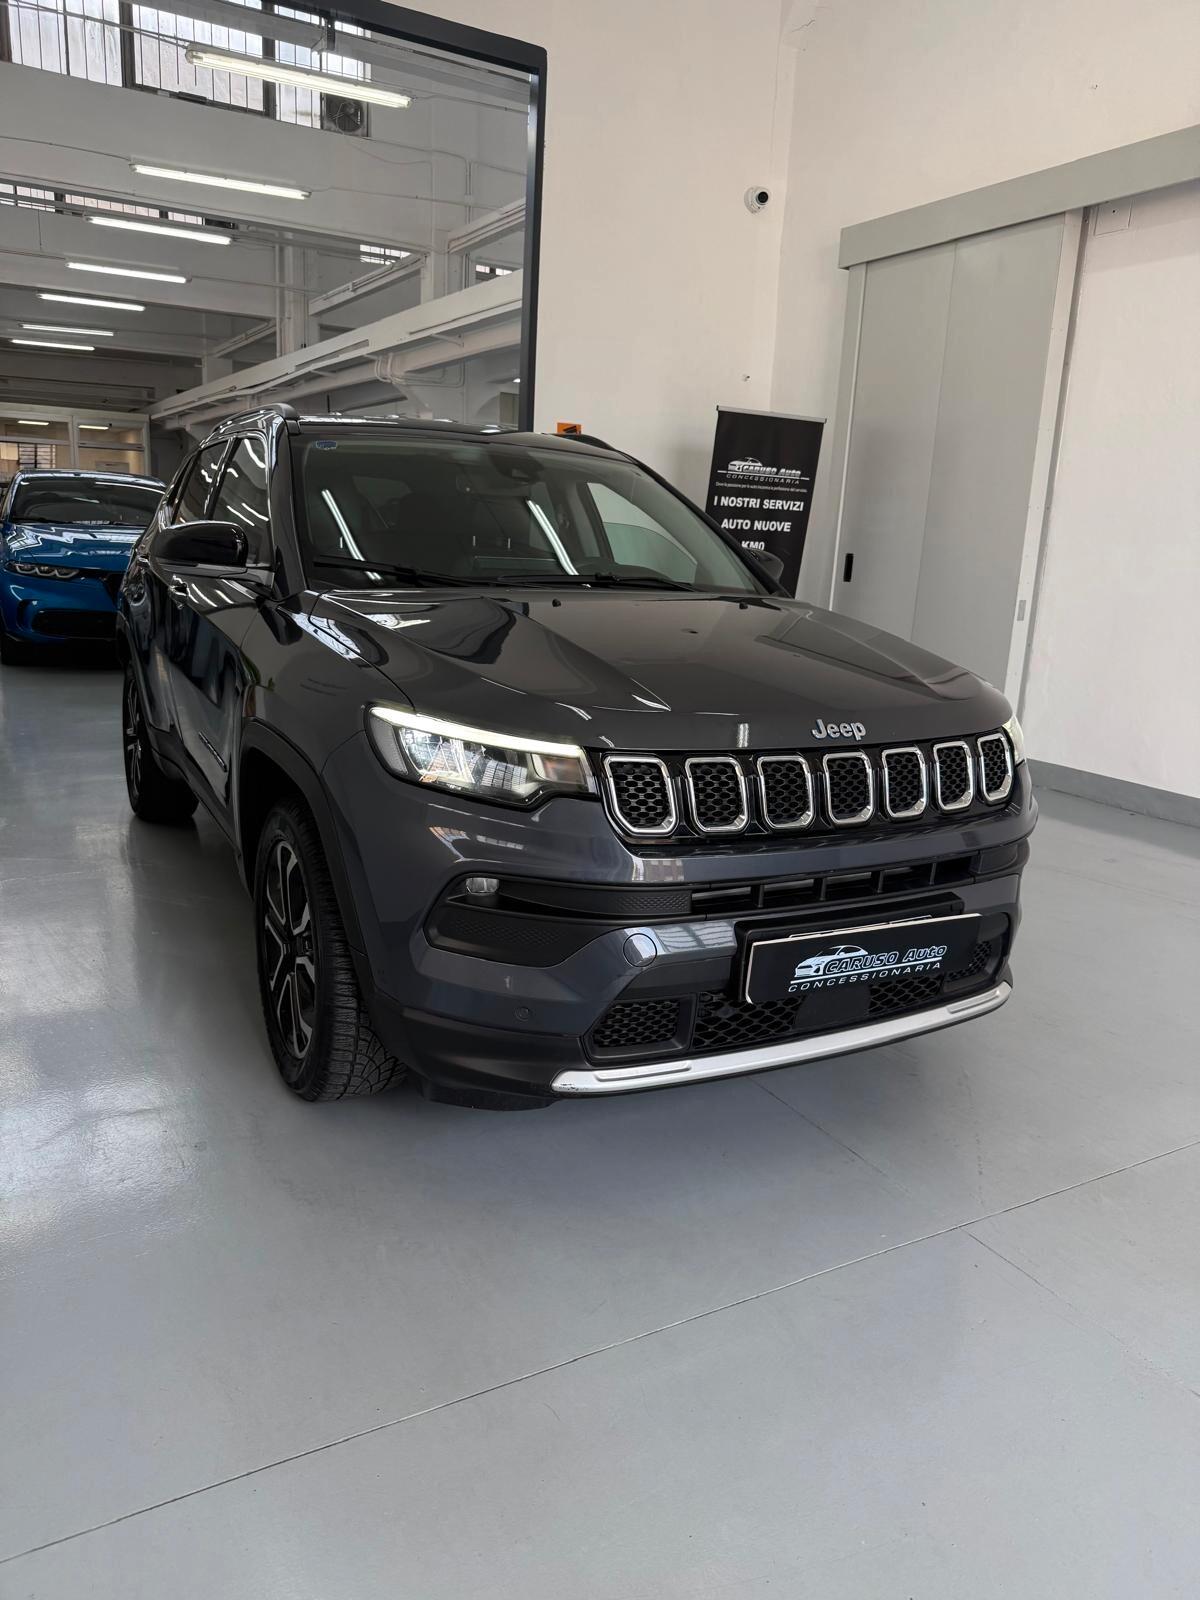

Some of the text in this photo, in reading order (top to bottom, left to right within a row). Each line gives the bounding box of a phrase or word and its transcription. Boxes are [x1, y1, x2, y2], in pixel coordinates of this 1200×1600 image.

[726, 474, 799, 484] CONCESSIONARIA
[713, 495, 804, 511] I NOSTRI SERVIZI
[721, 518, 792, 532] AUTO NUOVE
[811, 718, 867, 741] Jeep
[825, 945, 947, 975] CARUSO Auto
[788, 961, 941, 993] CONCESSIONARIA
